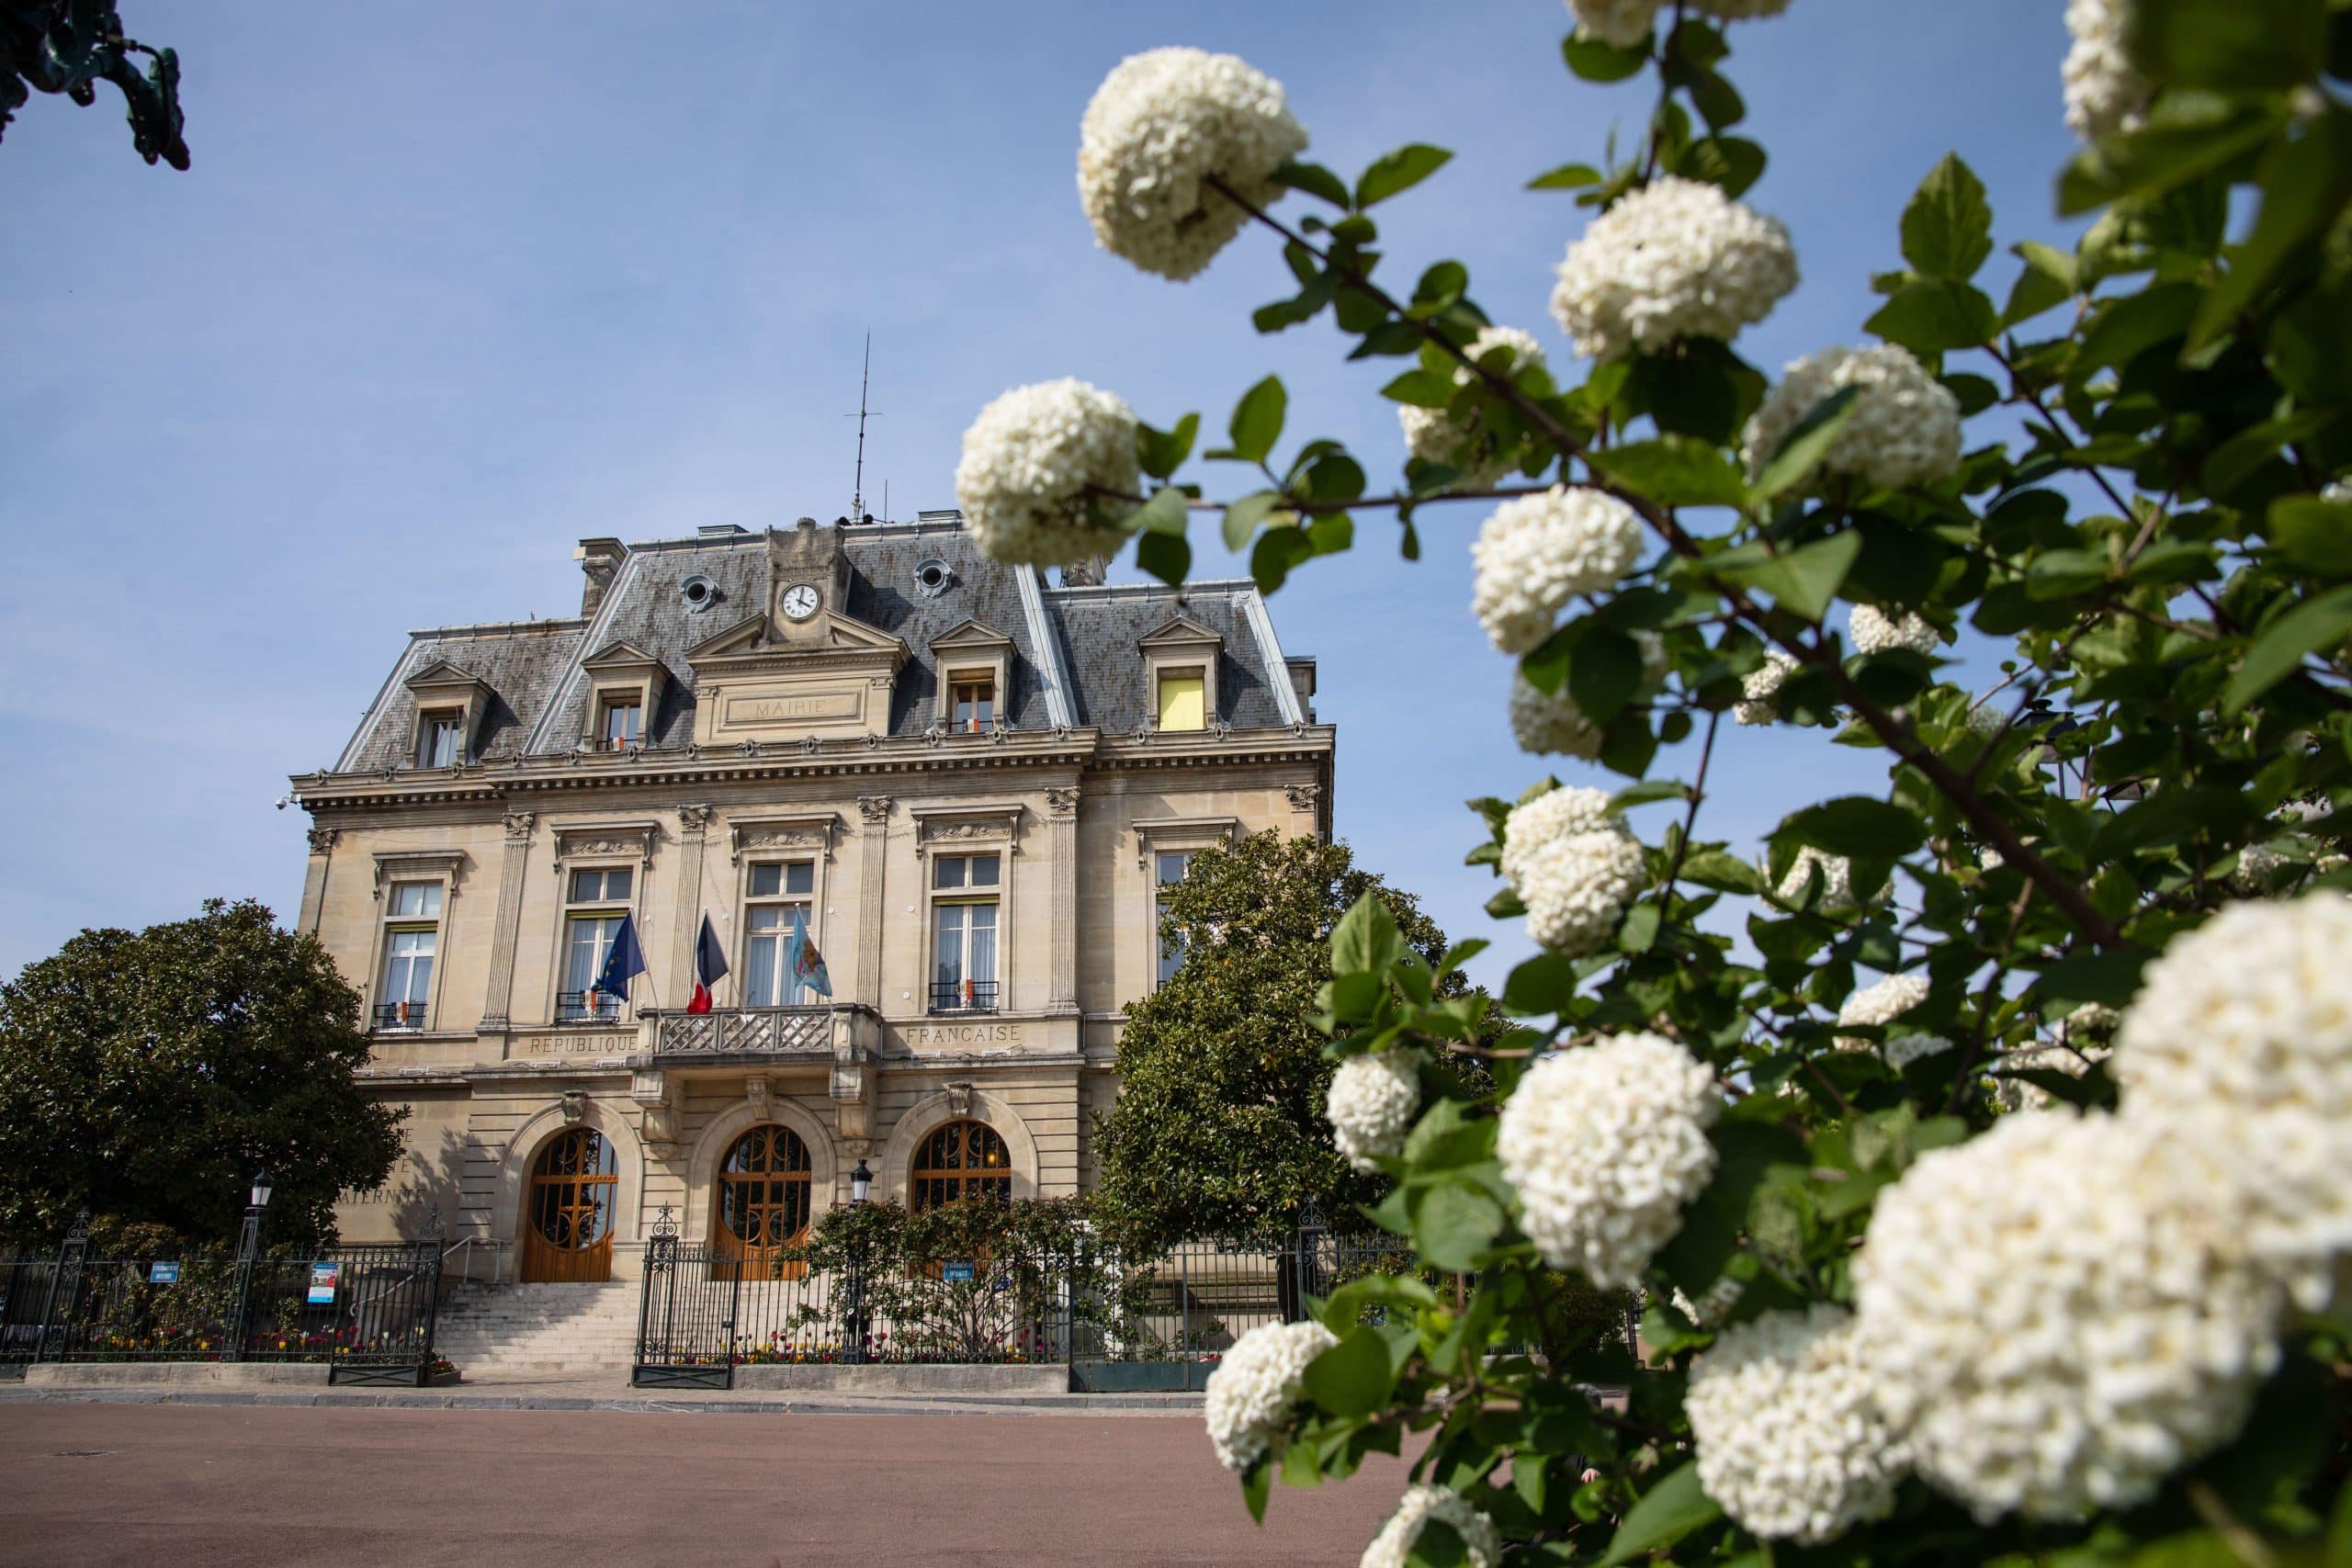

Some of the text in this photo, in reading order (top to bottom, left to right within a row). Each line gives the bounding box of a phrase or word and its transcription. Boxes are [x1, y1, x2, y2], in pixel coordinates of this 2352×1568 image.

[755, 699, 825, 716] MAIRIE
[529, 1024, 1022, 1053] REPUBLIQUE FRANCAISE
[338, 1189, 425, 1205] ATERNITE
